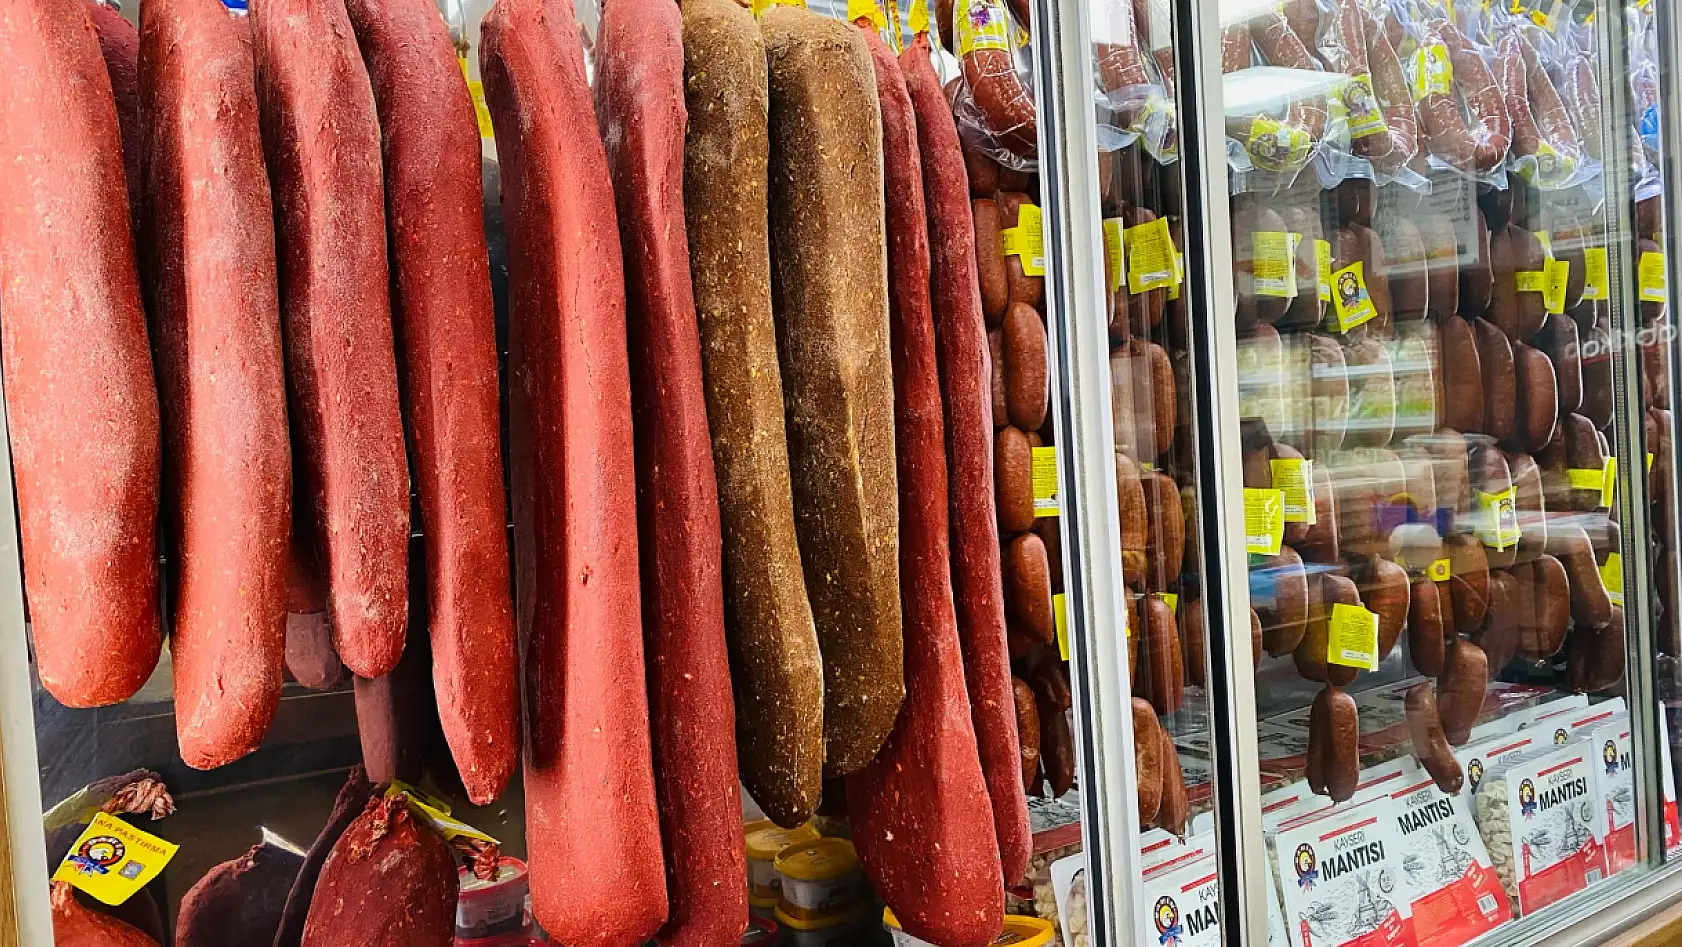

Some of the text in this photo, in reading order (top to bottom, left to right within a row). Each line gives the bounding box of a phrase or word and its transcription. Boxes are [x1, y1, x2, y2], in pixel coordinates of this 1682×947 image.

[1539, 776, 1588, 811] MANTISI
[1397, 797, 1455, 836] MANTISI
[1321, 840, 1386, 881] MANTISI
[1198, 884, 1219, 902] KAY
